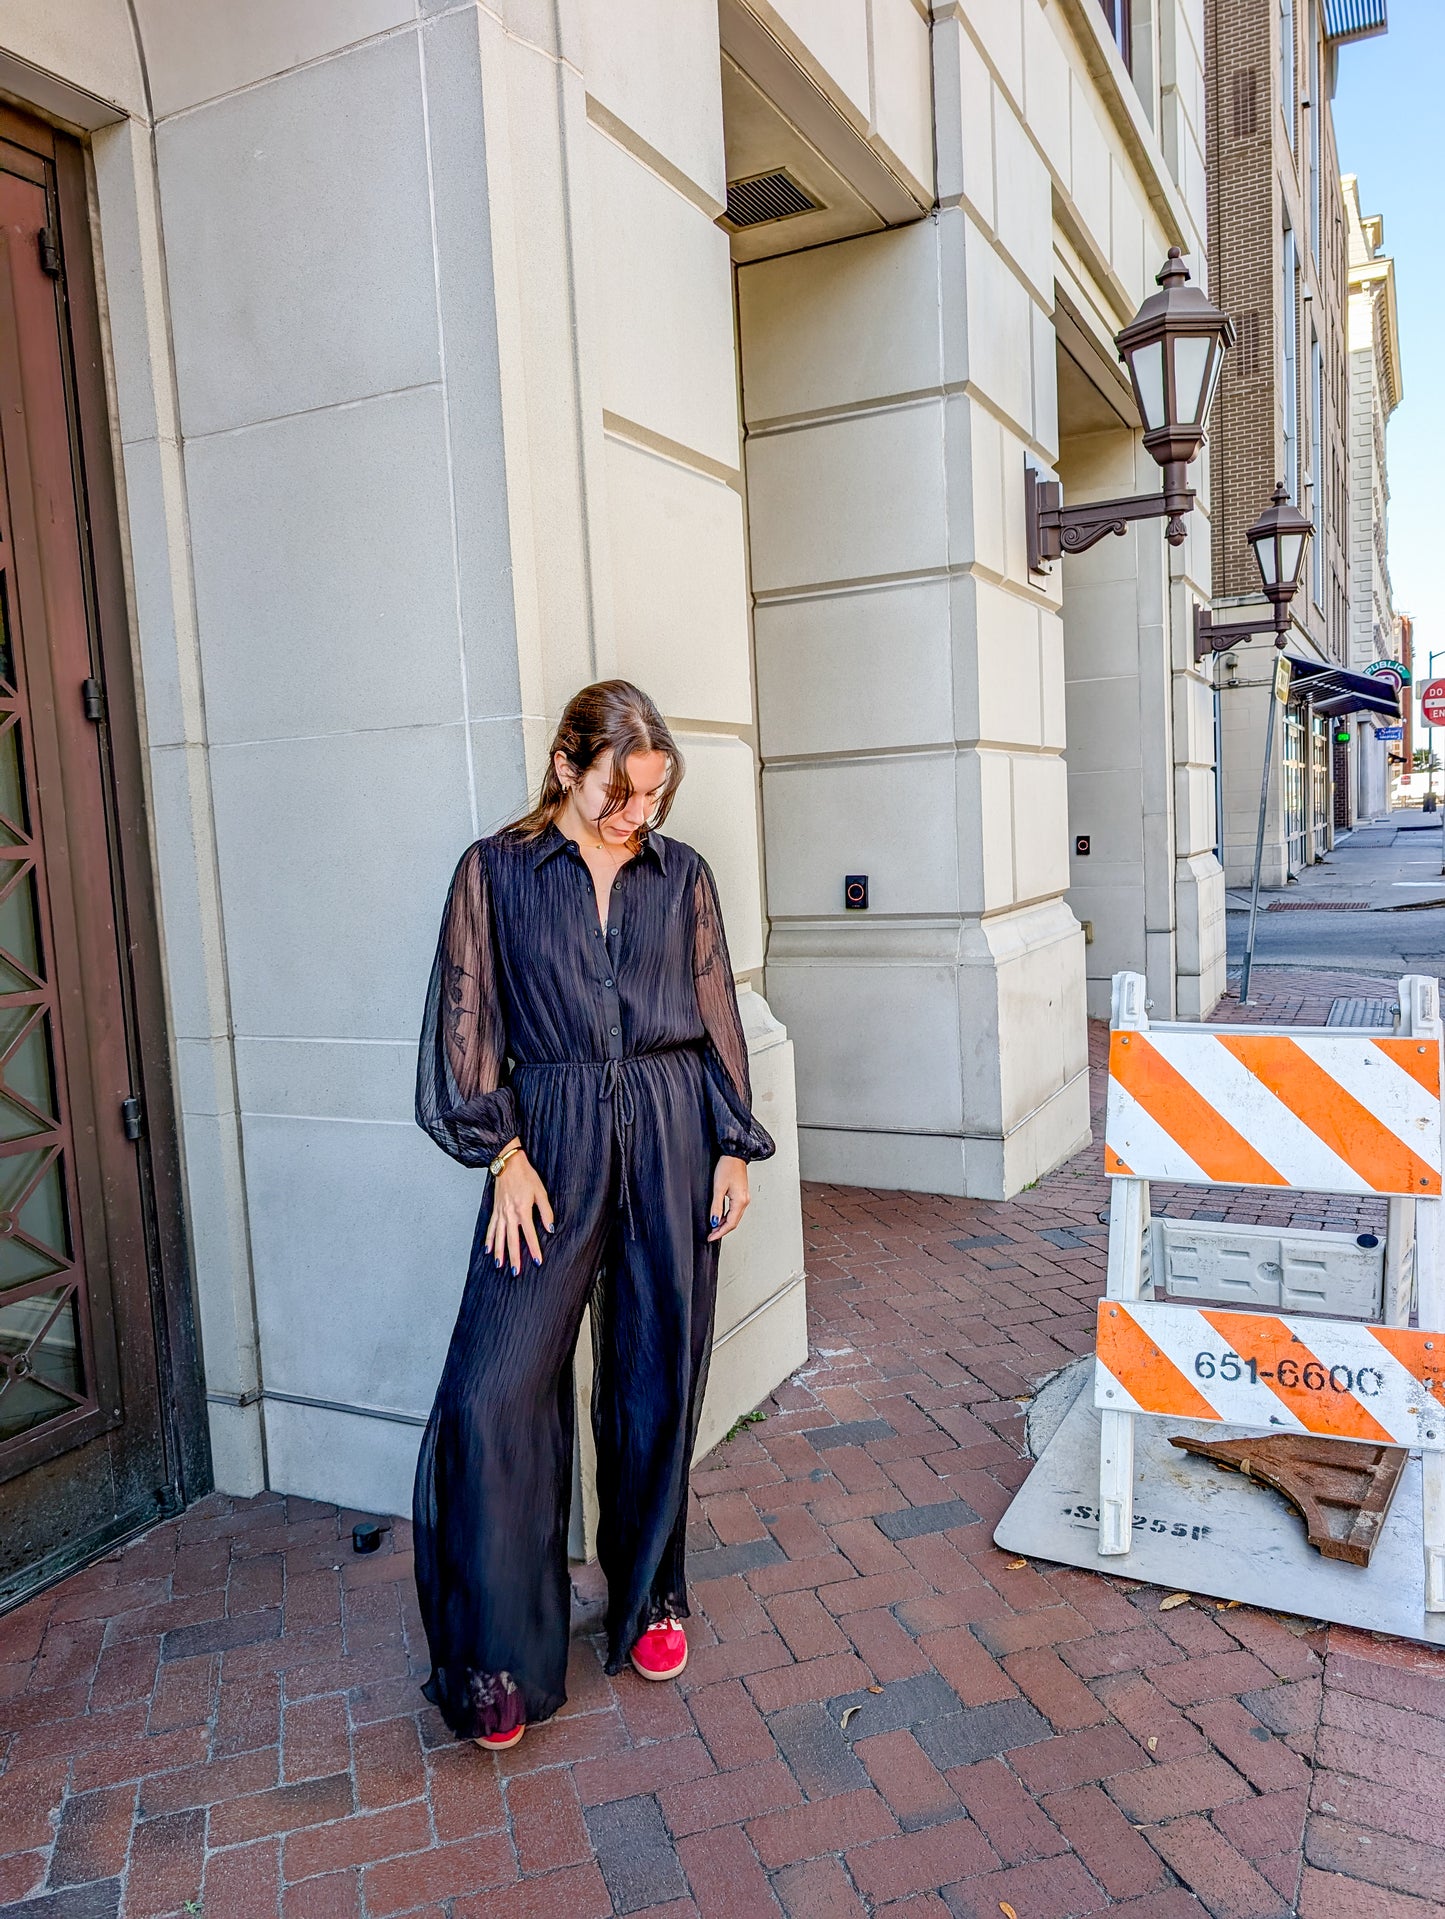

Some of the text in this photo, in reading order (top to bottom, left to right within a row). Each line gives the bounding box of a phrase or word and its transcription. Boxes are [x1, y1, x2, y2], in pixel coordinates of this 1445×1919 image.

[1365, 661, 1405, 675] PUBLIC
[1429, 688, 1443, 697] DO
[1195, 1352, 1384, 1397] 651-6600
